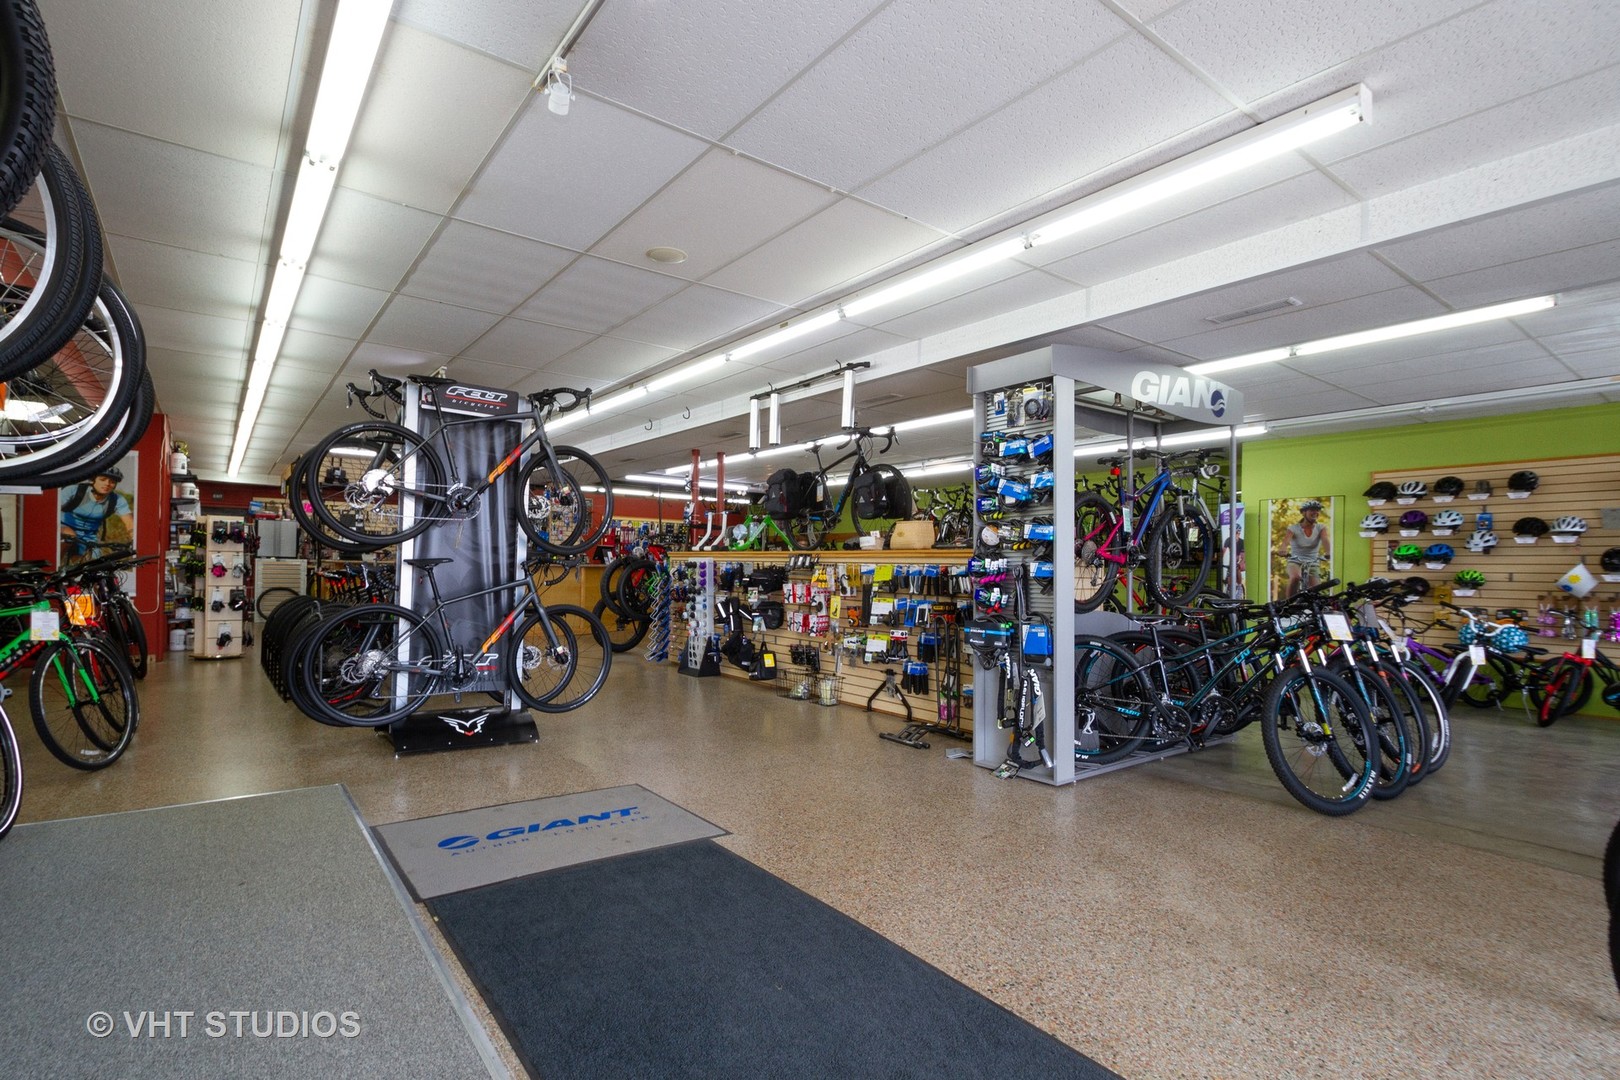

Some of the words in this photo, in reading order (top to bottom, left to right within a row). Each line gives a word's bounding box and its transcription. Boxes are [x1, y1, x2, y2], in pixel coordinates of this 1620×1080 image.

[446, 385, 508, 403] FELT
[451, 398, 501, 410] bicycles
[1027, 667, 1041, 696] GIAN
[1357, 769, 1377, 800] MAXXIS
[485, 806, 638, 841] GIANT
[451, 828, 575, 856] AUTHORED
